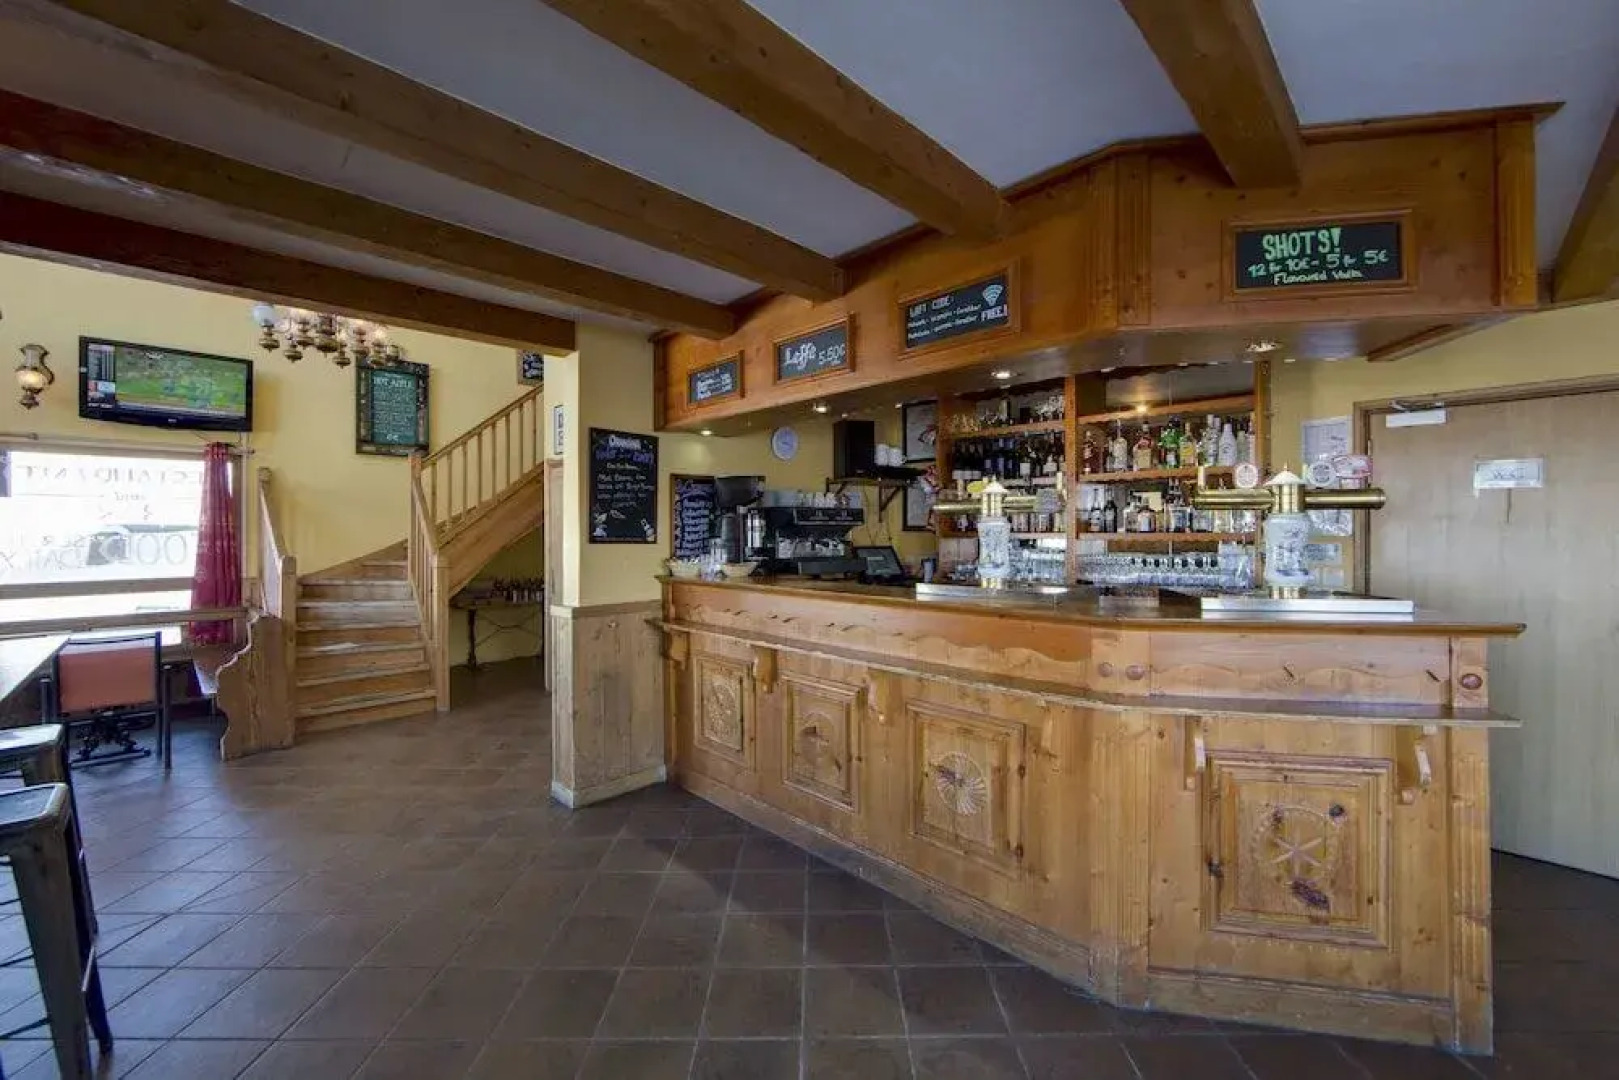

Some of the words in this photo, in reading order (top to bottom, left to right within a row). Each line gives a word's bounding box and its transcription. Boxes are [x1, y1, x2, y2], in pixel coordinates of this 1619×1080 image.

[1262, 227, 1341, 260] SHOTS!
[1248, 263, 1267, 277] 12
[1285, 257, 1310, 272] 10€
[1326, 254, 1340, 268] 5
[1364, 249, 1389, 264] 5€
